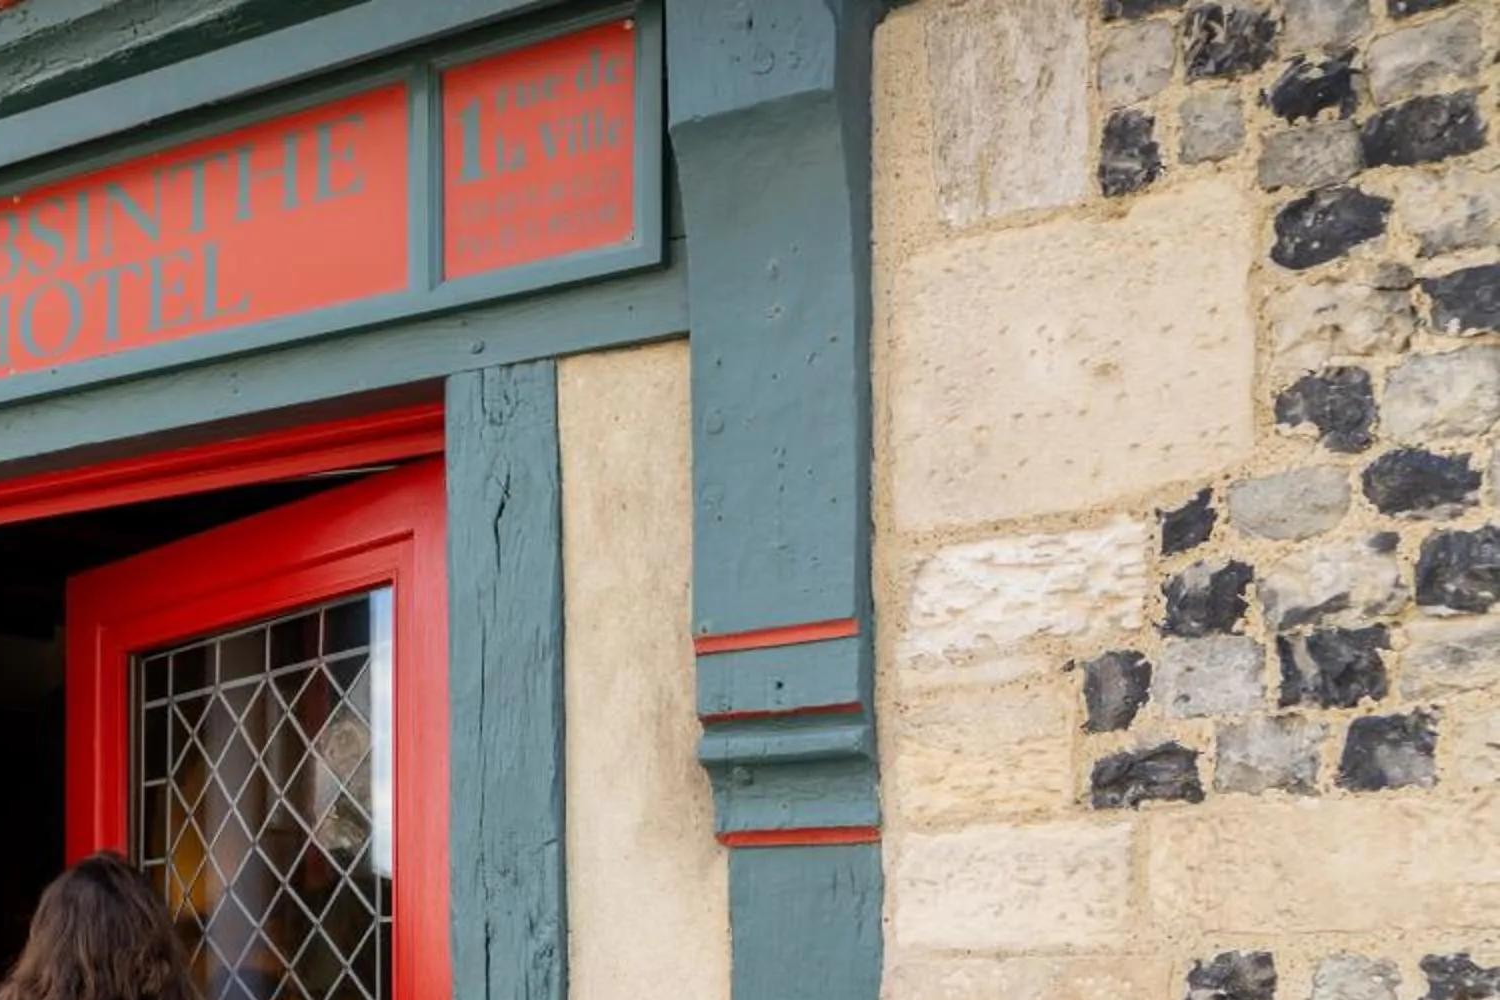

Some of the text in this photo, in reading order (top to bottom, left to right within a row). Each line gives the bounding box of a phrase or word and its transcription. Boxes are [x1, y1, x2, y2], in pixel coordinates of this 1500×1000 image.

[453, 48, 625, 186] 1 rue de
[496, 105, 625, 175] la Ville
